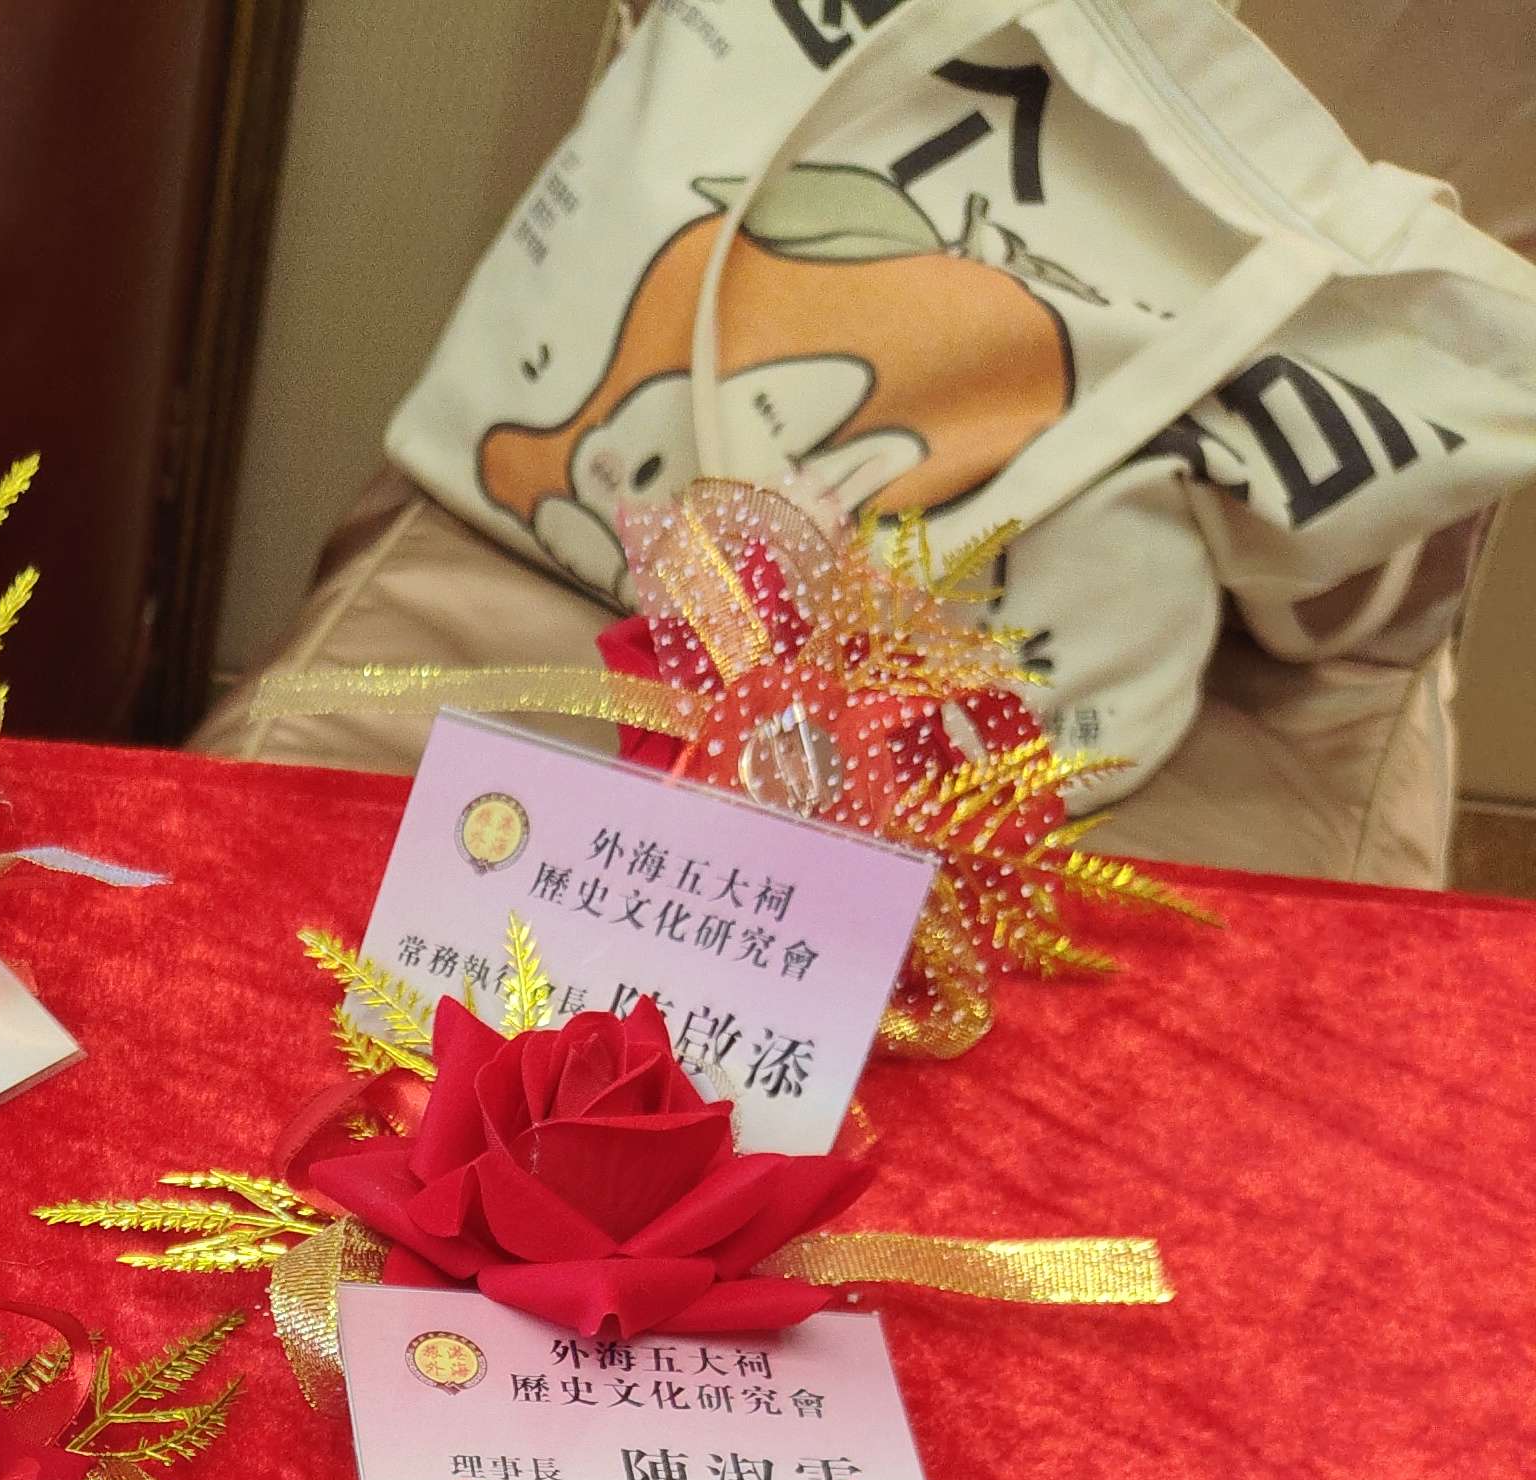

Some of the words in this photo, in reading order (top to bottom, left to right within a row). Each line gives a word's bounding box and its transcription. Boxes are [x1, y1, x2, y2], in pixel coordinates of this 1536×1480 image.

[586, 827, 797, 923] 外海五大祠
[528, 861, 821, 982] 歷史文化研究會
[397, 934, 587, 1016] 常務執長
[509, 1373, 826, 1420] 歷史文化研究會
[550, 1338, 772, 1382] 外海五大祠
